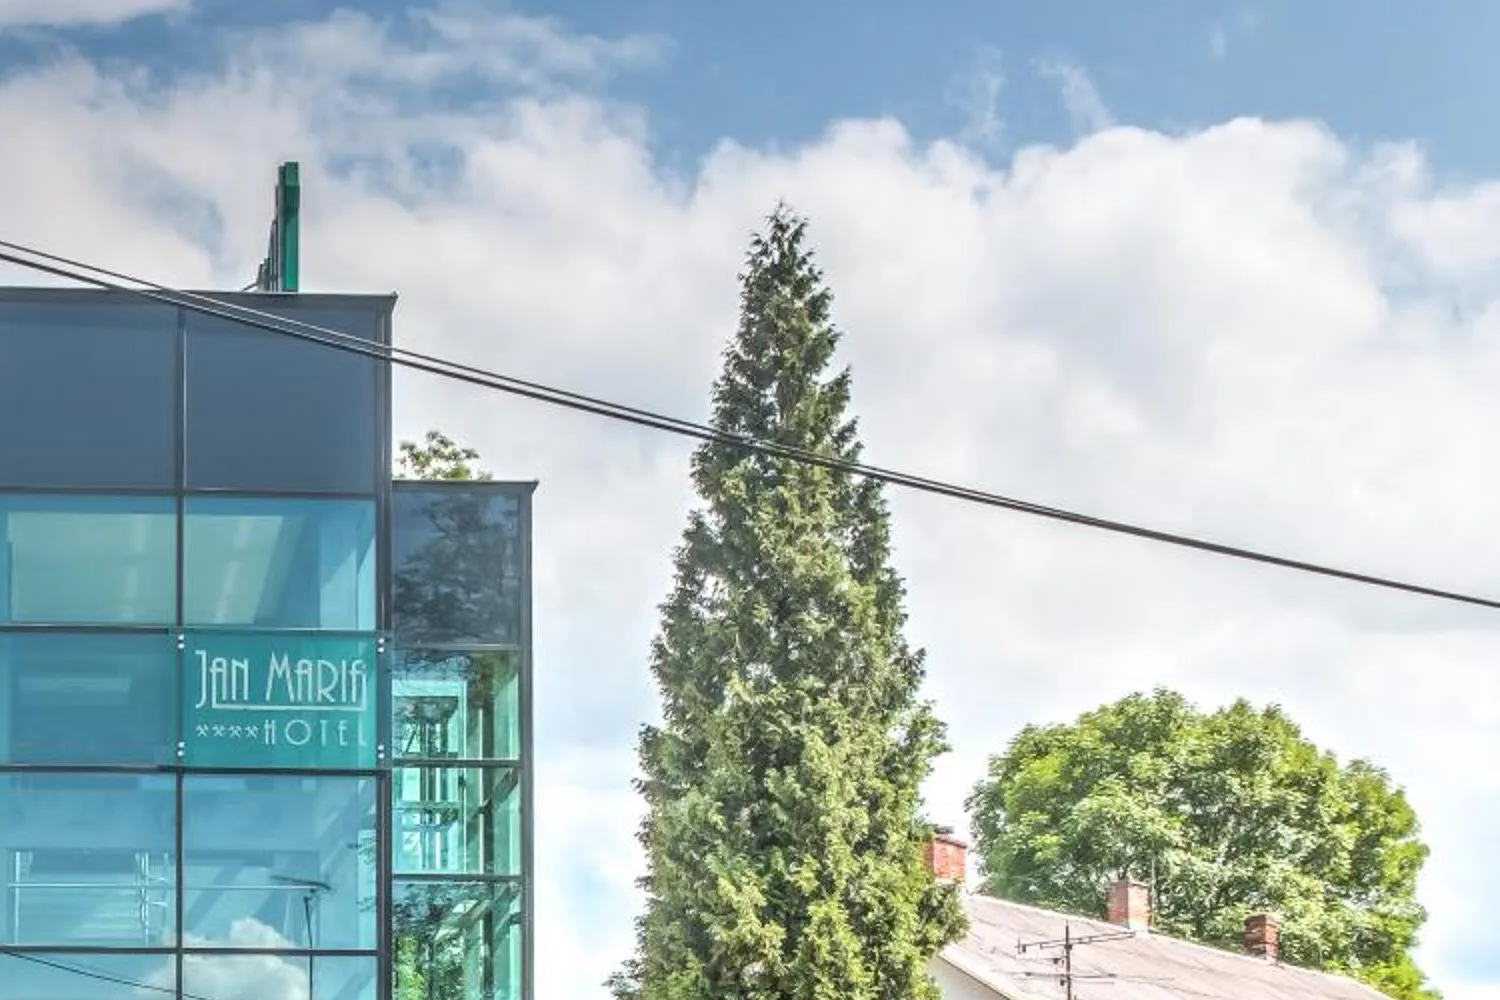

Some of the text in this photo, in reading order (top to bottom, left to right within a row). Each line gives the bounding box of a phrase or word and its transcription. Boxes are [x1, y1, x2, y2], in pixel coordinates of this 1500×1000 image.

[195, 650, 367, 708] JAN MARIA
[264, 719, 368, 746] HOTEL
